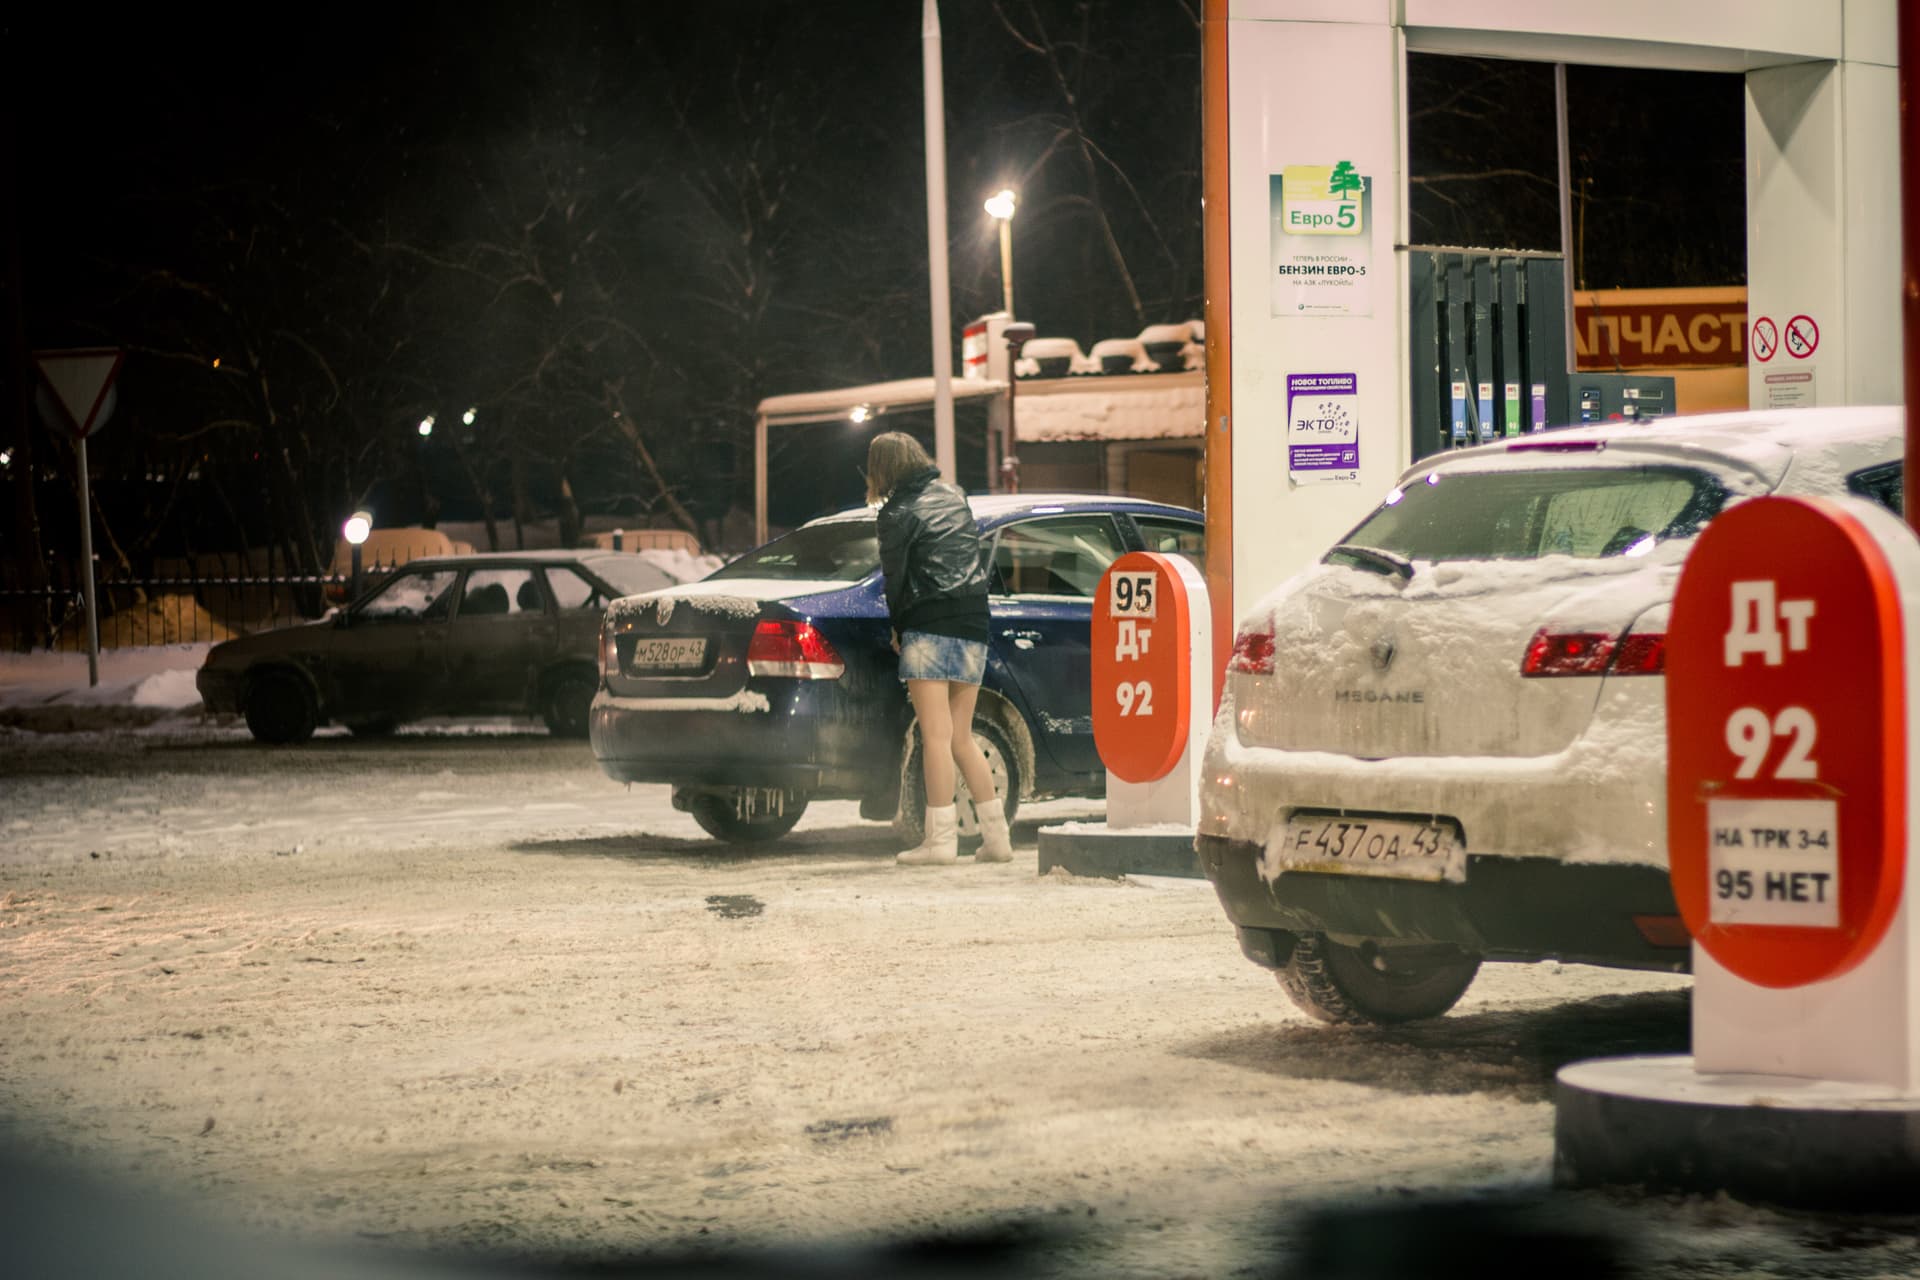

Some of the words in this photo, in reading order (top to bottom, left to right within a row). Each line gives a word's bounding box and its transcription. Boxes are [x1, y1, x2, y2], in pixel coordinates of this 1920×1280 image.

[1291, 210, 1334, 228] Евро
[1336, 204, 1356, 228] 5
[1279, 265, 1325, 275] БЕНЗИН
[1327, 265, 1367, 276] ЕВРО-5
[1296, 419, 1335, 431] ЭКТО
[1349, 471, 1357, 480] 5
[1116, 577, 1152, 612] 95
[689, 640, 702, 656] 43
[1116, 681, 1153, 717] 92
[1335, 690, 1425, 703] MEGANE
[1725, 706, 1818, 779] 92
[1412, 826, 1443, 855] 43
[1715, 828, 1743, 847] НА
[1751, 828, 1790, 849] ТРК
[1798, 829, 1829, 849] 3-4
[1716, 870, 1754, 900] 95
[1765, 871, 1831, 903] НЕТ
